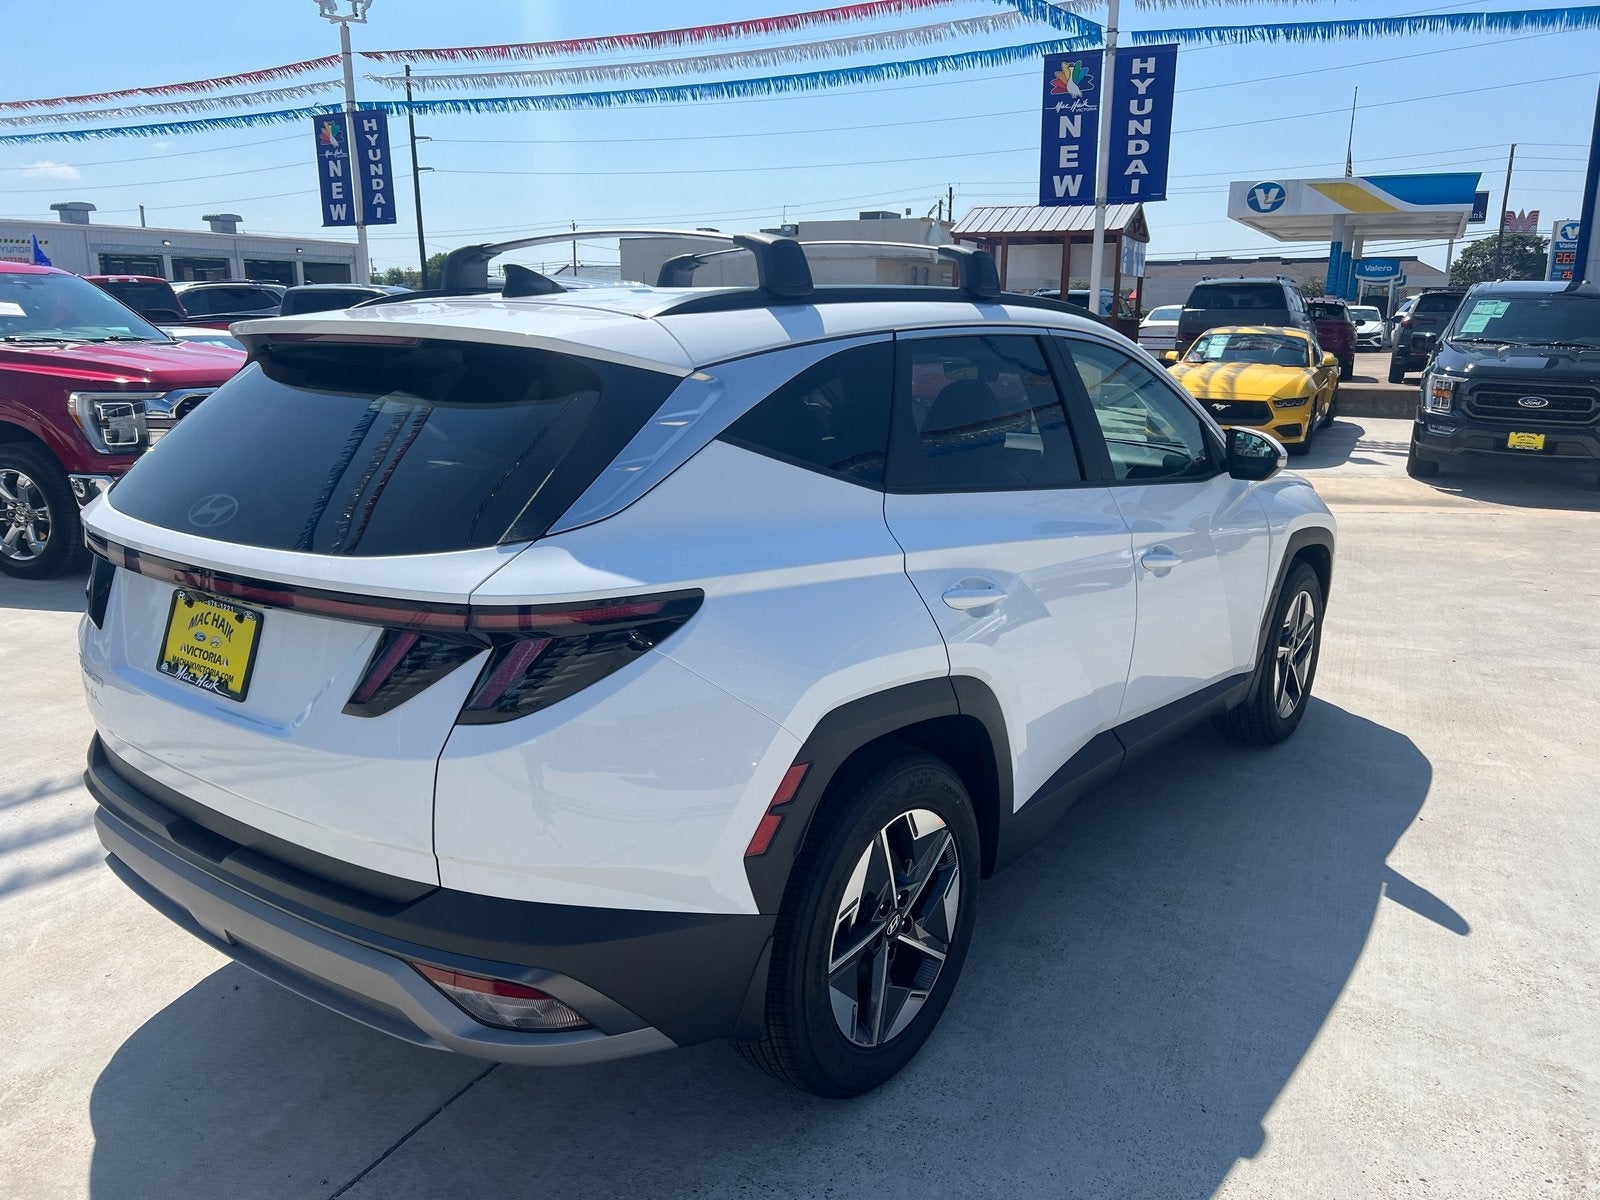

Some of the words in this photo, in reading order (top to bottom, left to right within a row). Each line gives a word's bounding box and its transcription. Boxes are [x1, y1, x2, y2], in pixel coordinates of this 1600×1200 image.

[1052, 114, 1083, 198] NEW
[1124, 57, 1156, 195] HYUNDAI
[328, 160, 347, 221] NEW
[362, 118, 386, 219] HYUNDAI
[186, 644, 222, 666] VICTORIA
[188, 611, 210, 631] MAC
[211, 612, 234, 643] HAIK
[173, 664, 196, 684] Mac
